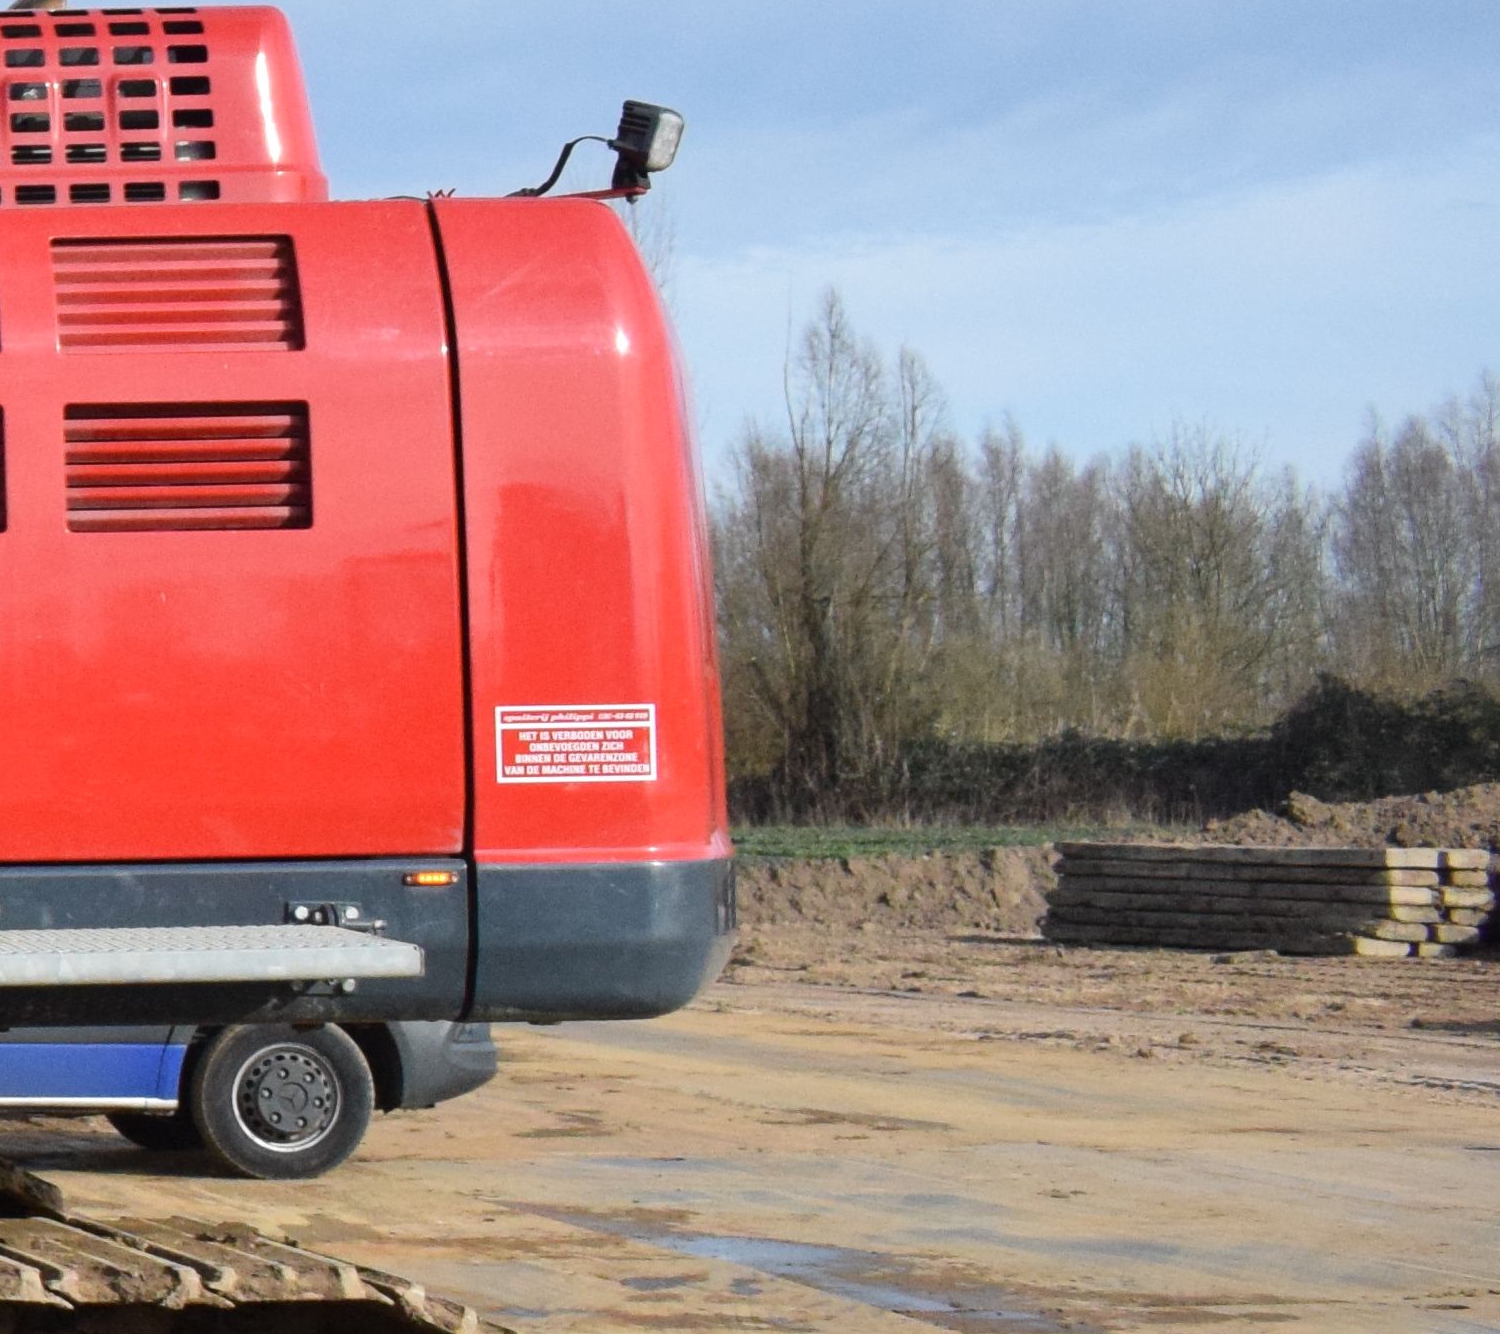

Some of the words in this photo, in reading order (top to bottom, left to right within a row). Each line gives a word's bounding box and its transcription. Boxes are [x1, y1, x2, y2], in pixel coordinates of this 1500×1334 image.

[519, 731, 537, 741] HET
[540, 731, 550, 741] IS
[552, 730, 604, 741] VERBODEN
[605, 729, 633, 739] VOOR
[529, 742, 599, 752] ONBEVOEGDEN
[601, 741, 624, 751] ZICH
[515, 753, 551, 763] BINNEN
[553, 753, 567, 763] DE
[568, 752, 638, 763] GEVARENZONE
[504, 765, 524, 775] VAN
[526, 765, 540, 775] DE
[542, 764, 585, 775] MACHINE
[588, 764, 600, 774] TE
[602, 763, 649, 774] BEVINDEN
